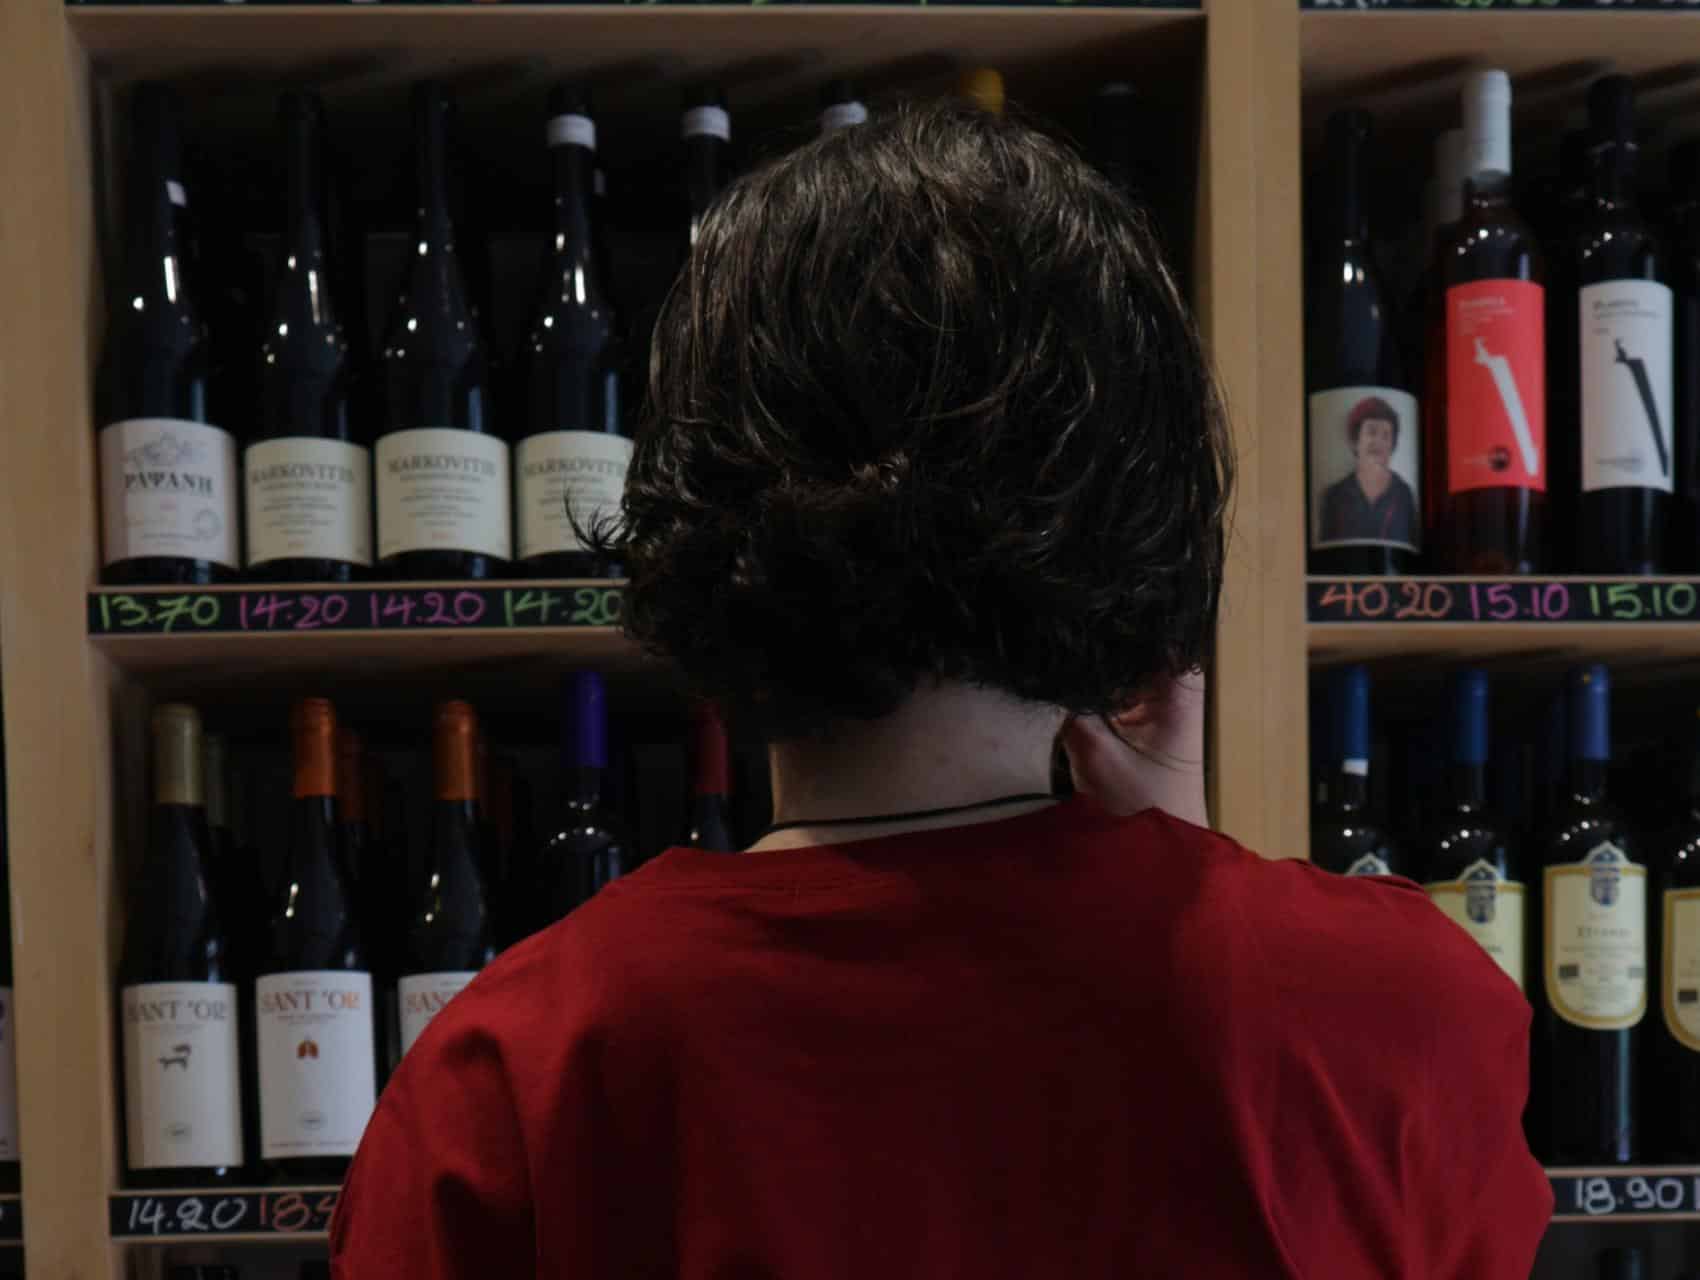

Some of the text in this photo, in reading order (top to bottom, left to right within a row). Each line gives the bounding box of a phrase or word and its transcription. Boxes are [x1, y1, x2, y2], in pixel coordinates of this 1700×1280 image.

[100, 593, 221, 629] 13.70
[240, 593, 349, 628] 14.20
[369, 590, 487, 625] 14.20
[1319, 583, 1697, 619] 40.20 15.10 15.10
[1576, 1177, 1684, 1215] 18.90
[128, 1197, 248, 1235] 14.20
